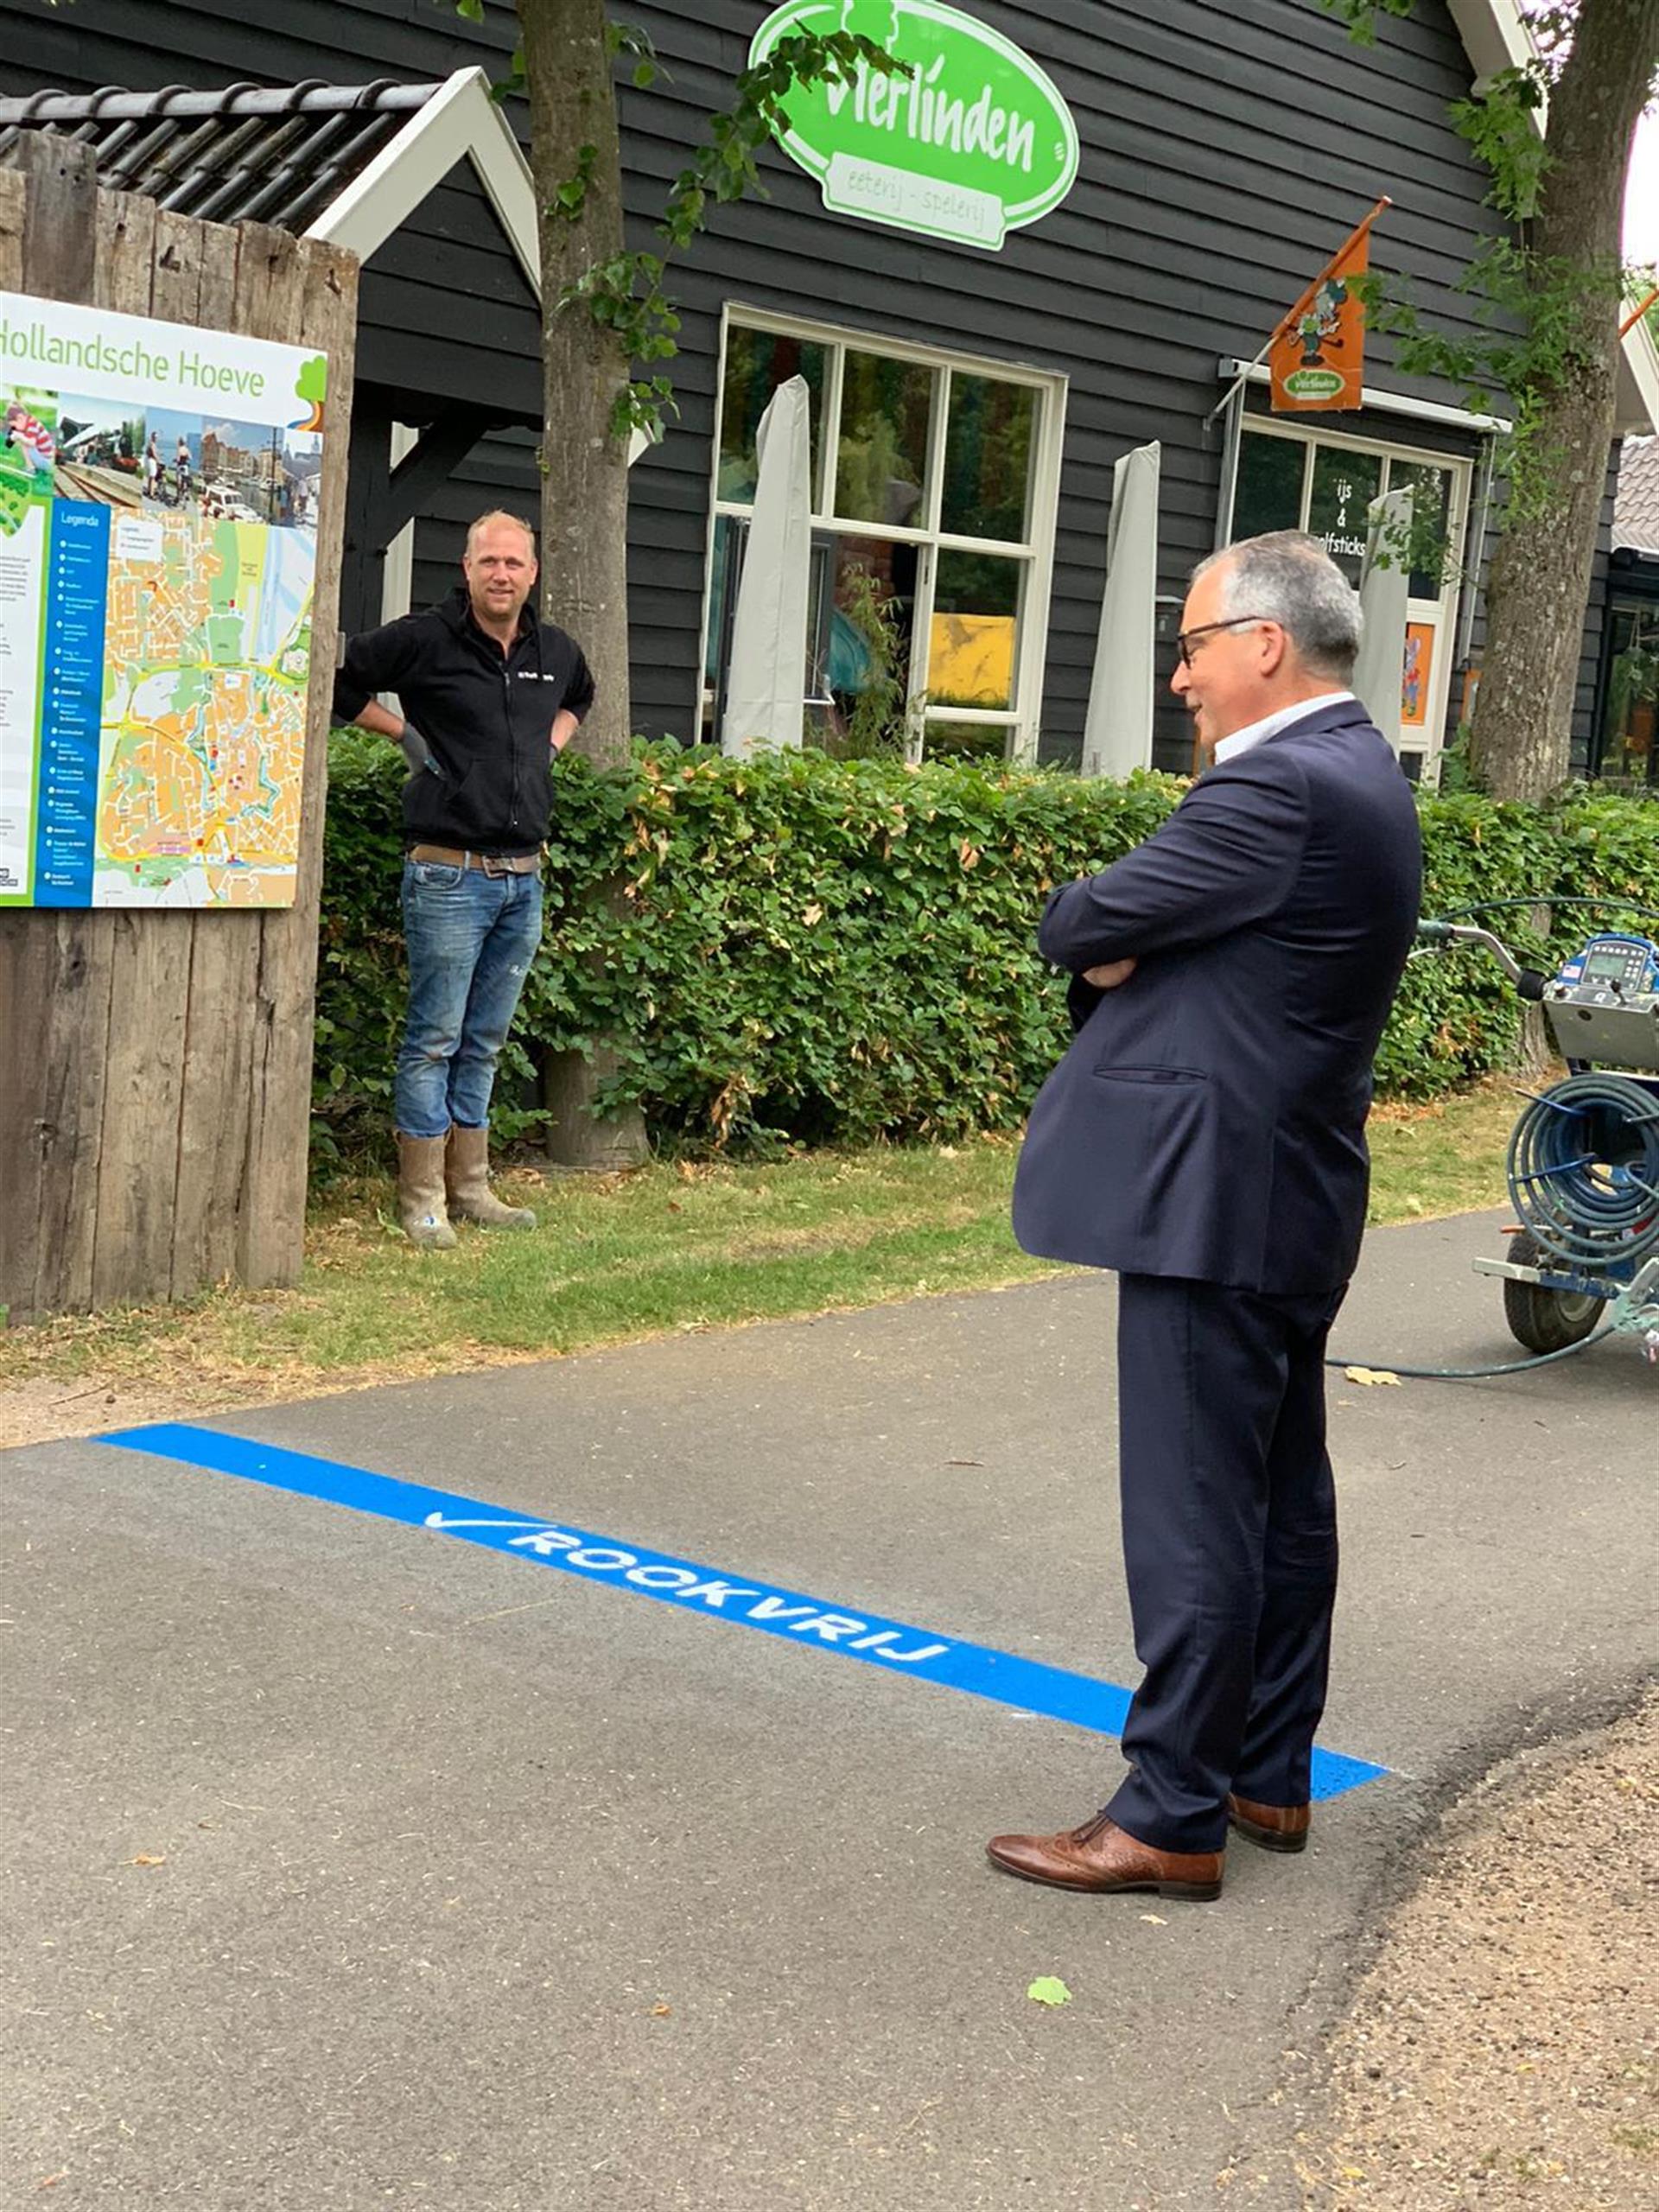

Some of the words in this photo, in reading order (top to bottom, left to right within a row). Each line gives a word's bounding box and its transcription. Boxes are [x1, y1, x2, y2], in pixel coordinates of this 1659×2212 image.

[848, 170, 903, 212] eeterij
[921, 191, 985, 233] spelerij
[178, 350, 264, 397] Hoeve
[61, 511, 99, 528] Legenda
[1337, 508, 1346, 528] &
[1315, 532, 1366, 556] olfsticks
[507, 1530, 950, 1662] ROOKVRIJ
